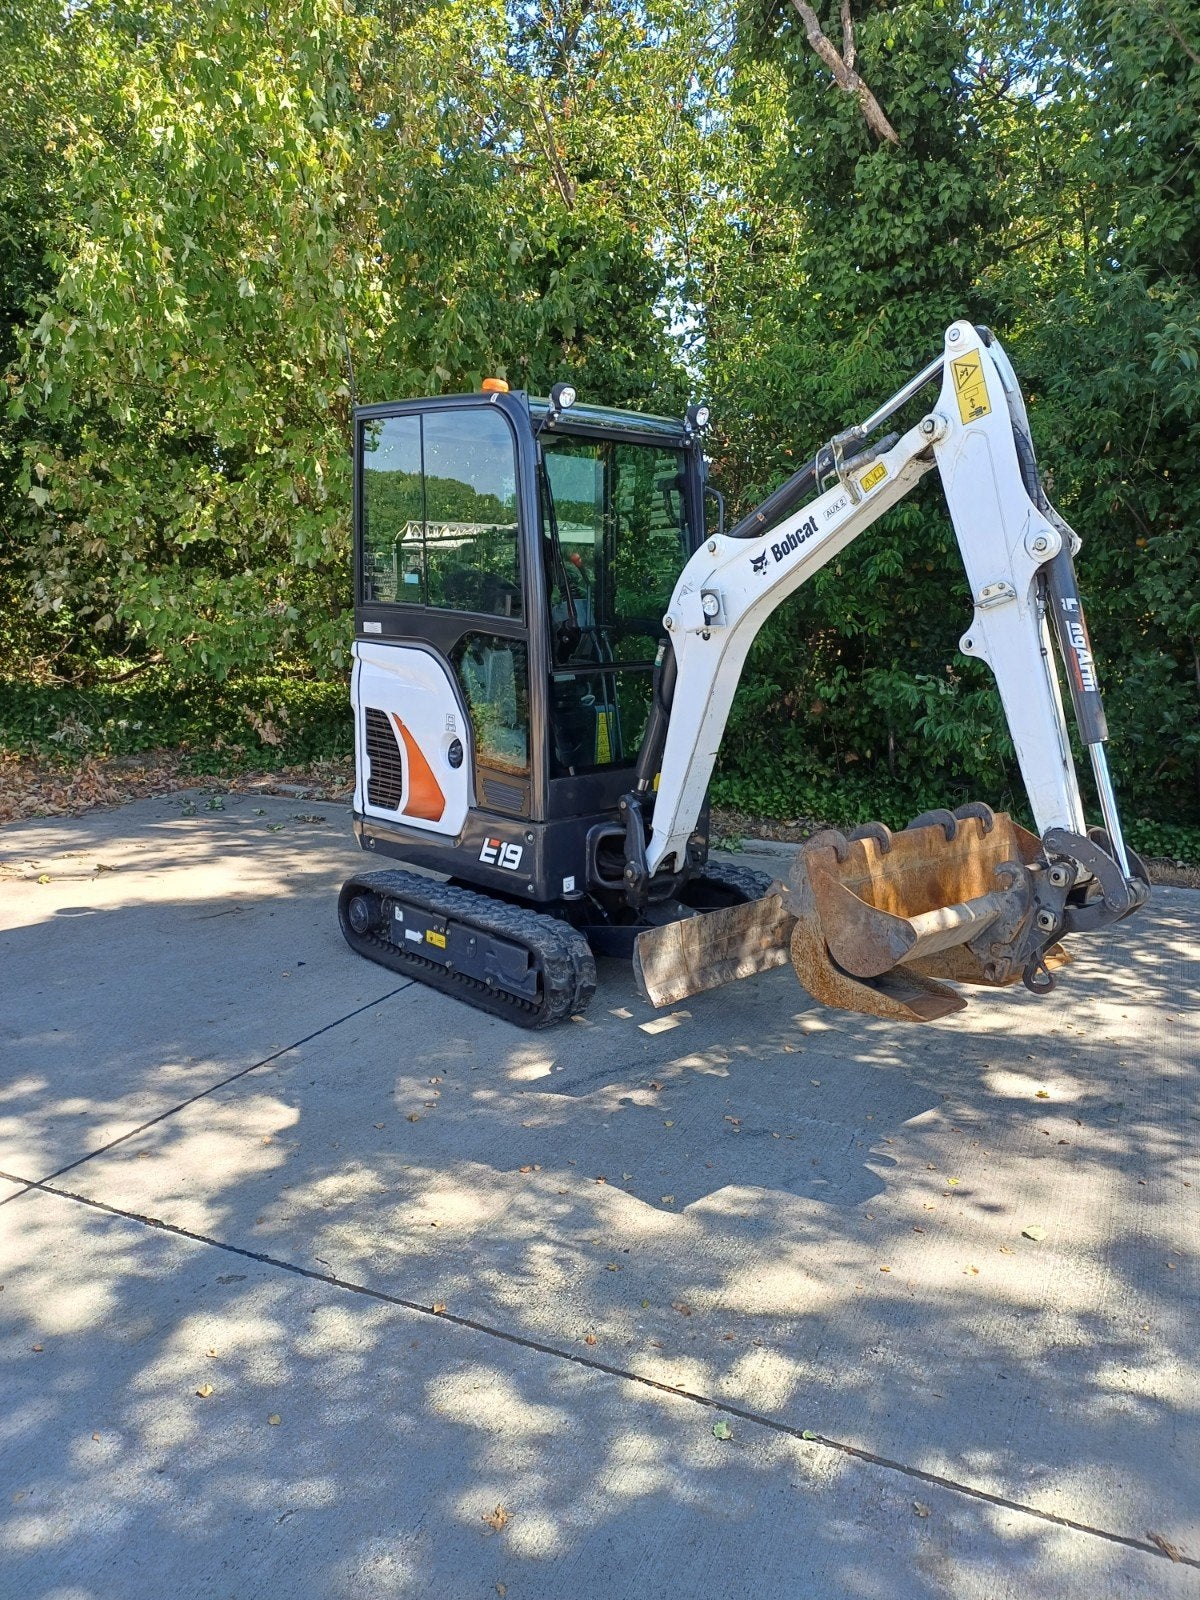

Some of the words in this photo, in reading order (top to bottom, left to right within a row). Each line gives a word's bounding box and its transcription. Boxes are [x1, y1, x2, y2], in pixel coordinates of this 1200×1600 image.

[826, 503, 841, 518] AUX
[771, 515, 819, 562] Bobcat
[1060, 598, 1096, 691] LngArm
[478, 837, 523, 870] E19
